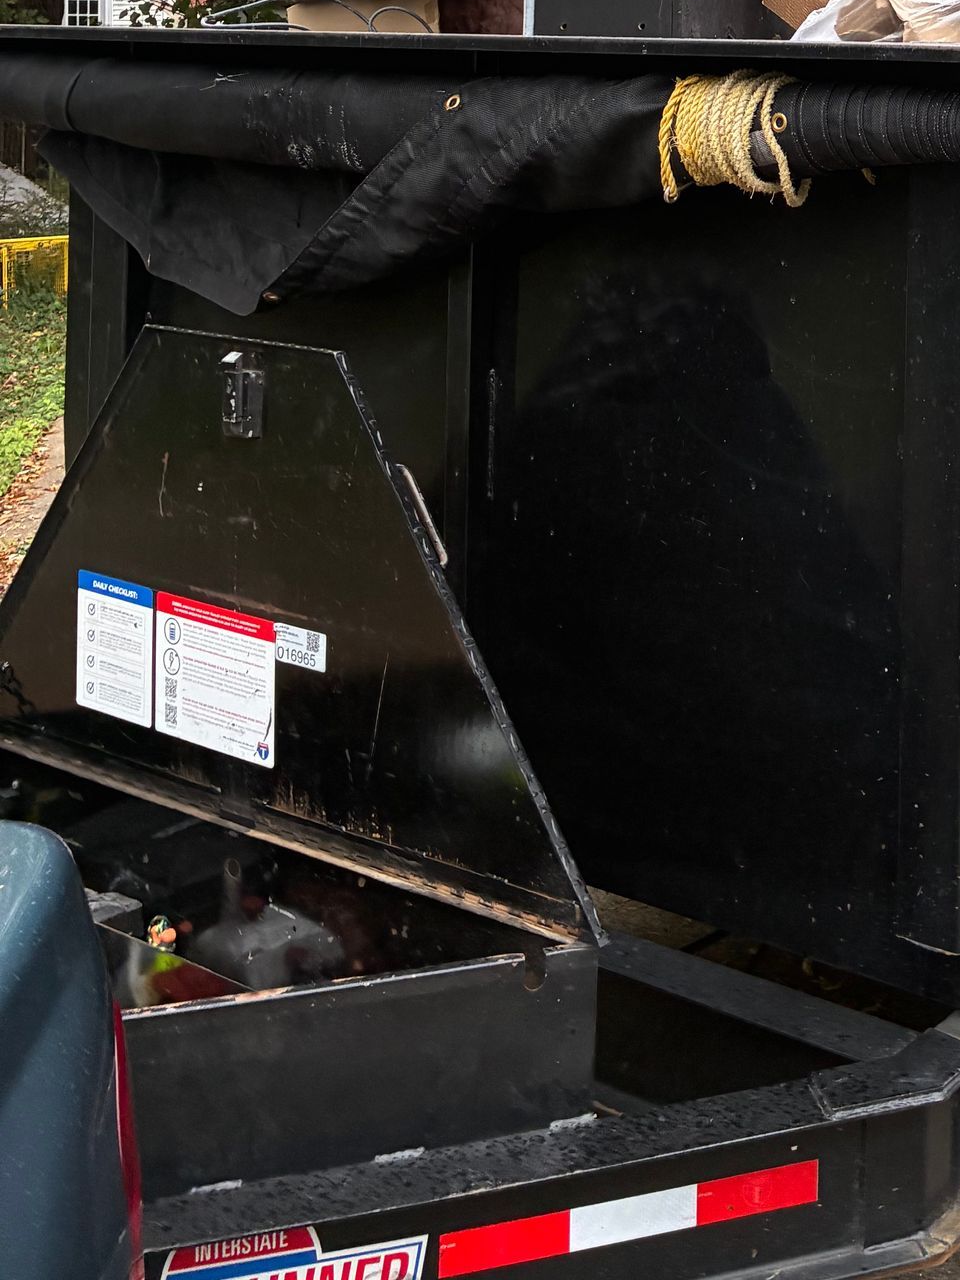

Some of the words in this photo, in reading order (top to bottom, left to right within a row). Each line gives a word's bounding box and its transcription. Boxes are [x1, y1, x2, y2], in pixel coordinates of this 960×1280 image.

[92, 580, 108, 591] DAILY
[277, 646, 316, 667] 016965
[194, 1230, 288, 1262] INTERSTATE
